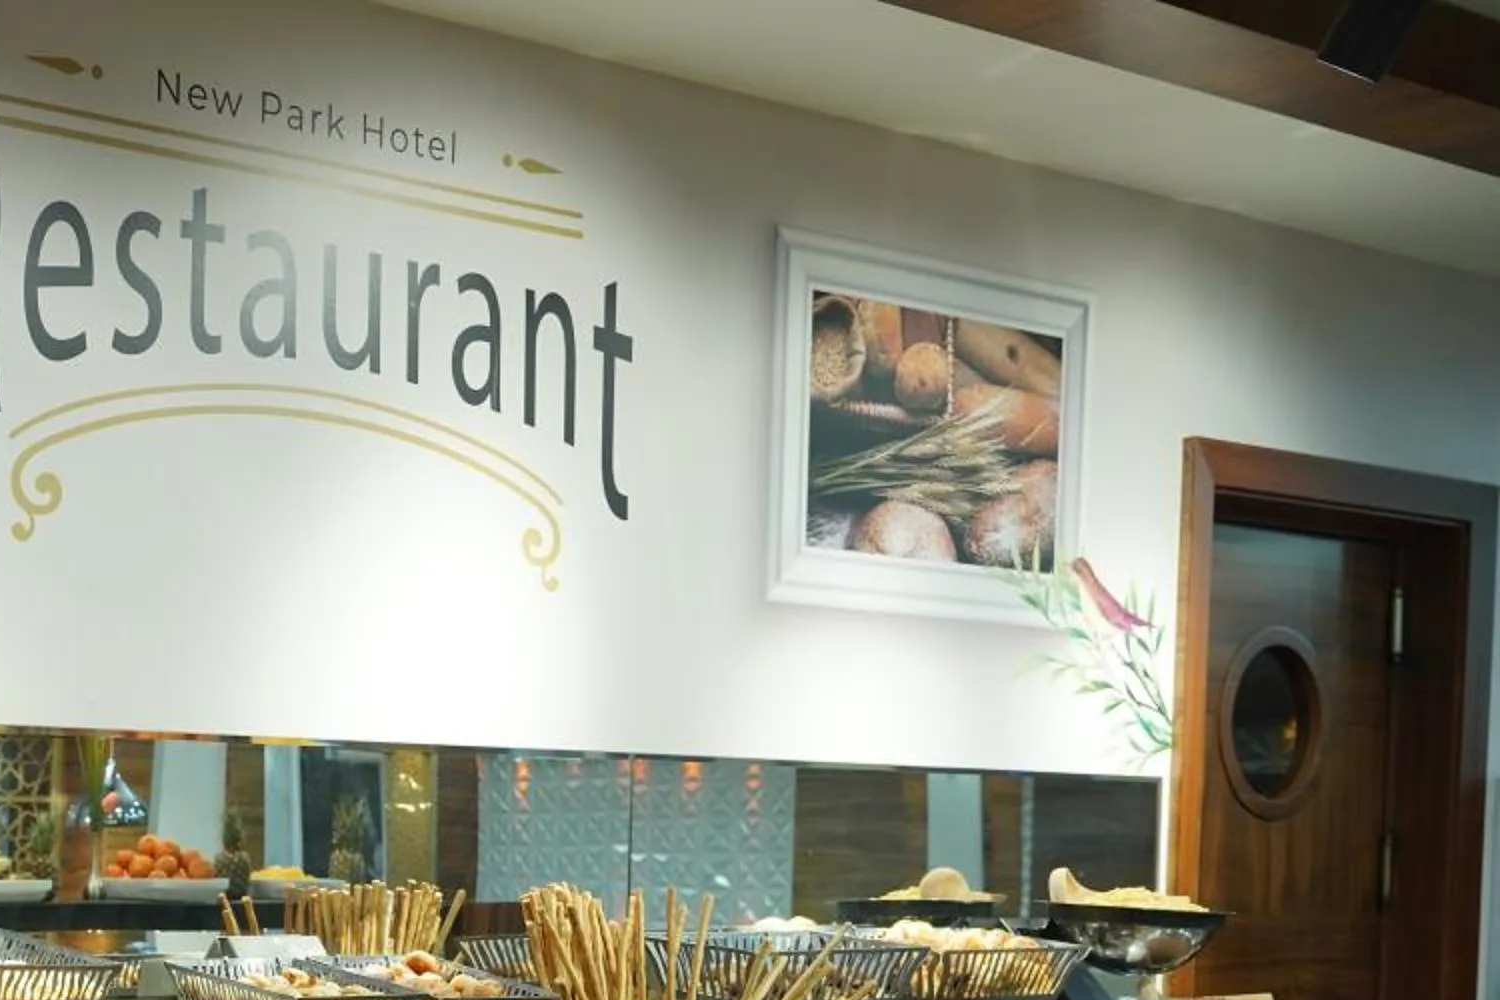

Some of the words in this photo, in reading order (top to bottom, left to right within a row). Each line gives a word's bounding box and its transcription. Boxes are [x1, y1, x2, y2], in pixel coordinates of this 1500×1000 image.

[155, 68, 243, 117] New
[261, 91, 345, 139] Park
[363, 113, 457, 164] Hotel
